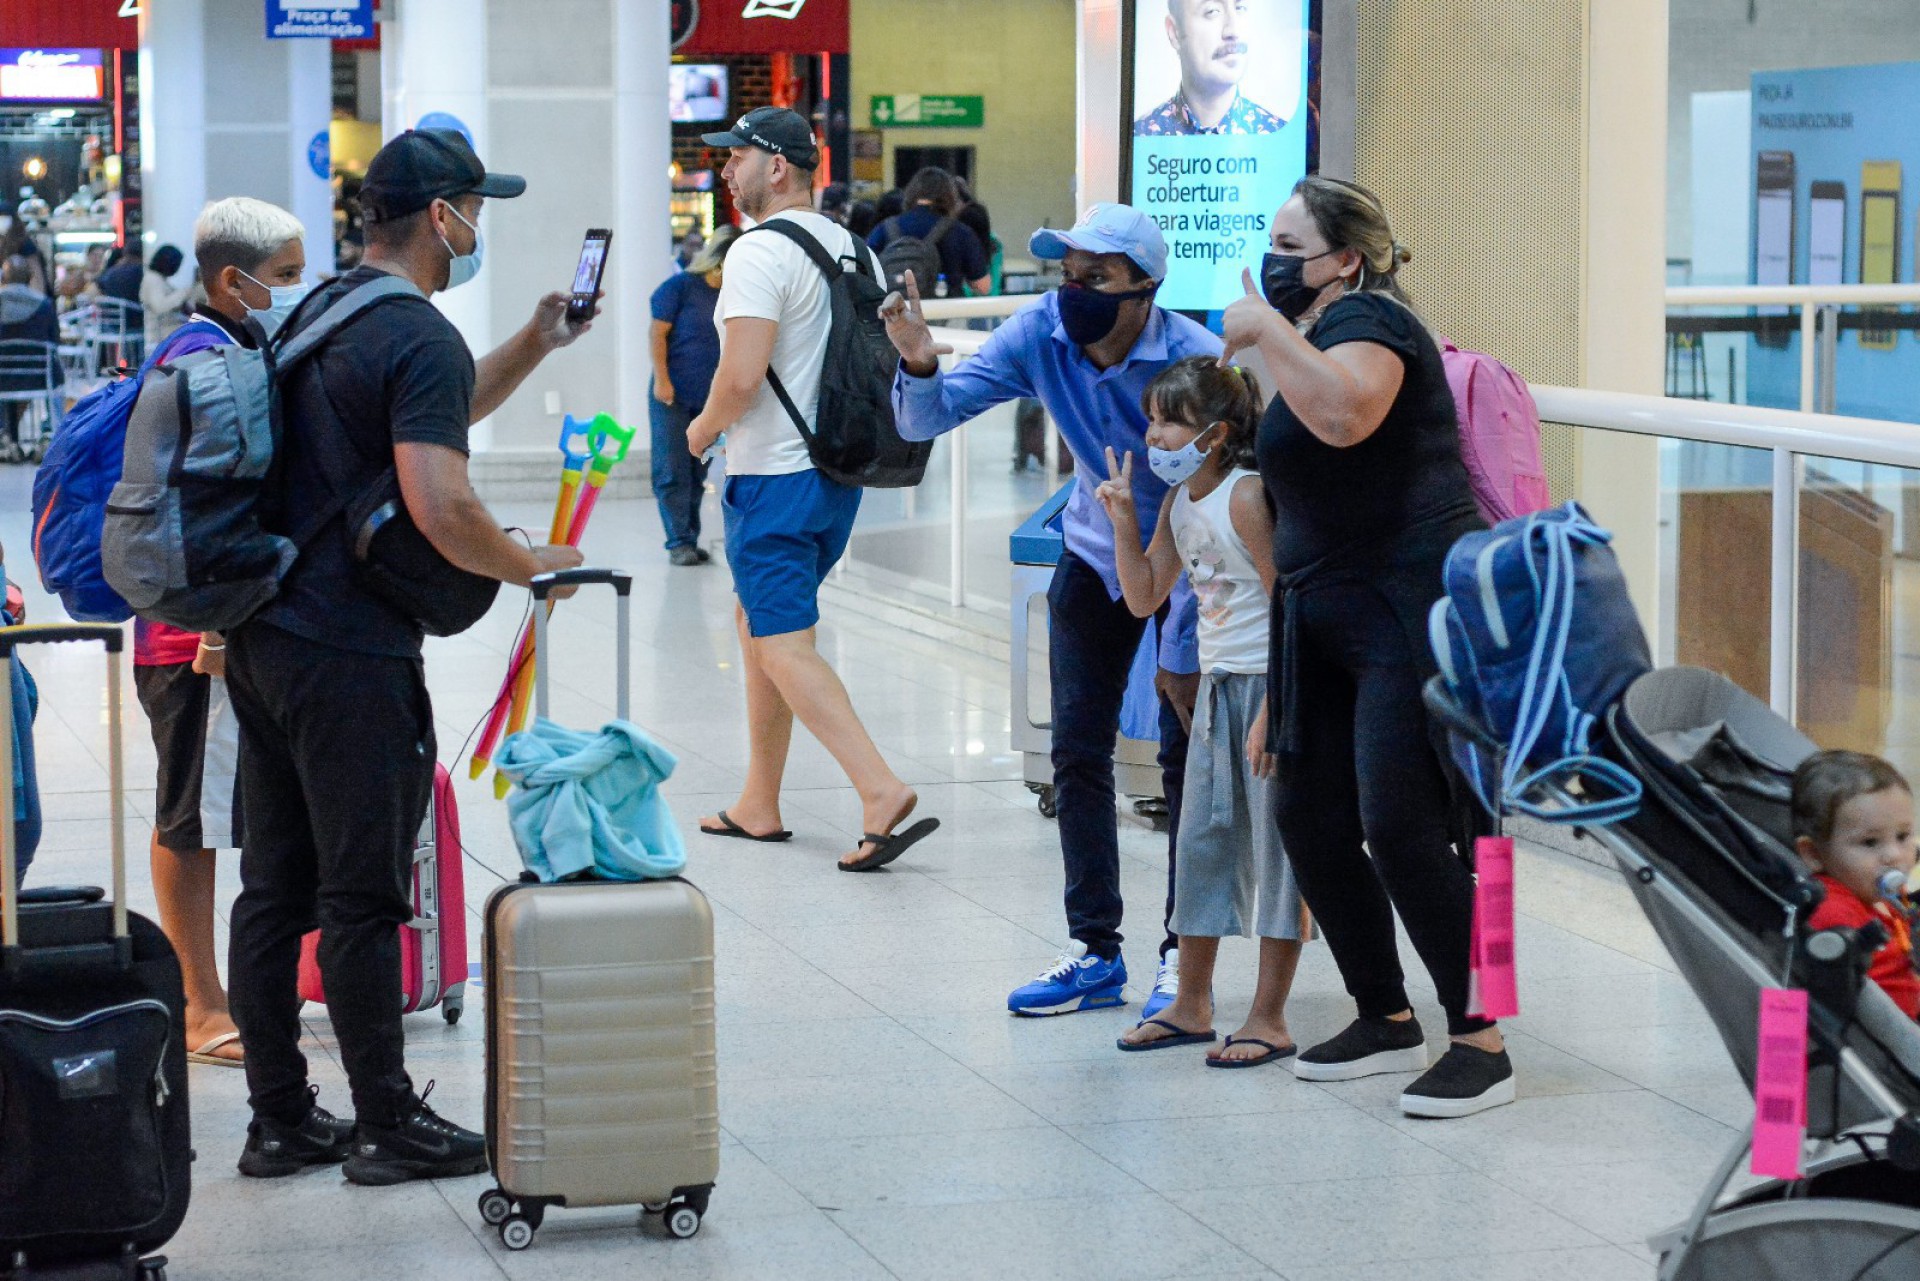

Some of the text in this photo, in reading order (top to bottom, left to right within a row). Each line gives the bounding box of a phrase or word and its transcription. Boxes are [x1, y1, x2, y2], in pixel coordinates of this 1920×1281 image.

[288, 9, 351, 24] Praça de
[273, 21, 365, 39] alimentação
[1147, 154, 1257, 181] Seguro com
[1147, 180, 1239, 203] cobertura
[1193, 208, 1266, 237] viagens
[1174, 237, 1246, 265] tempo?
